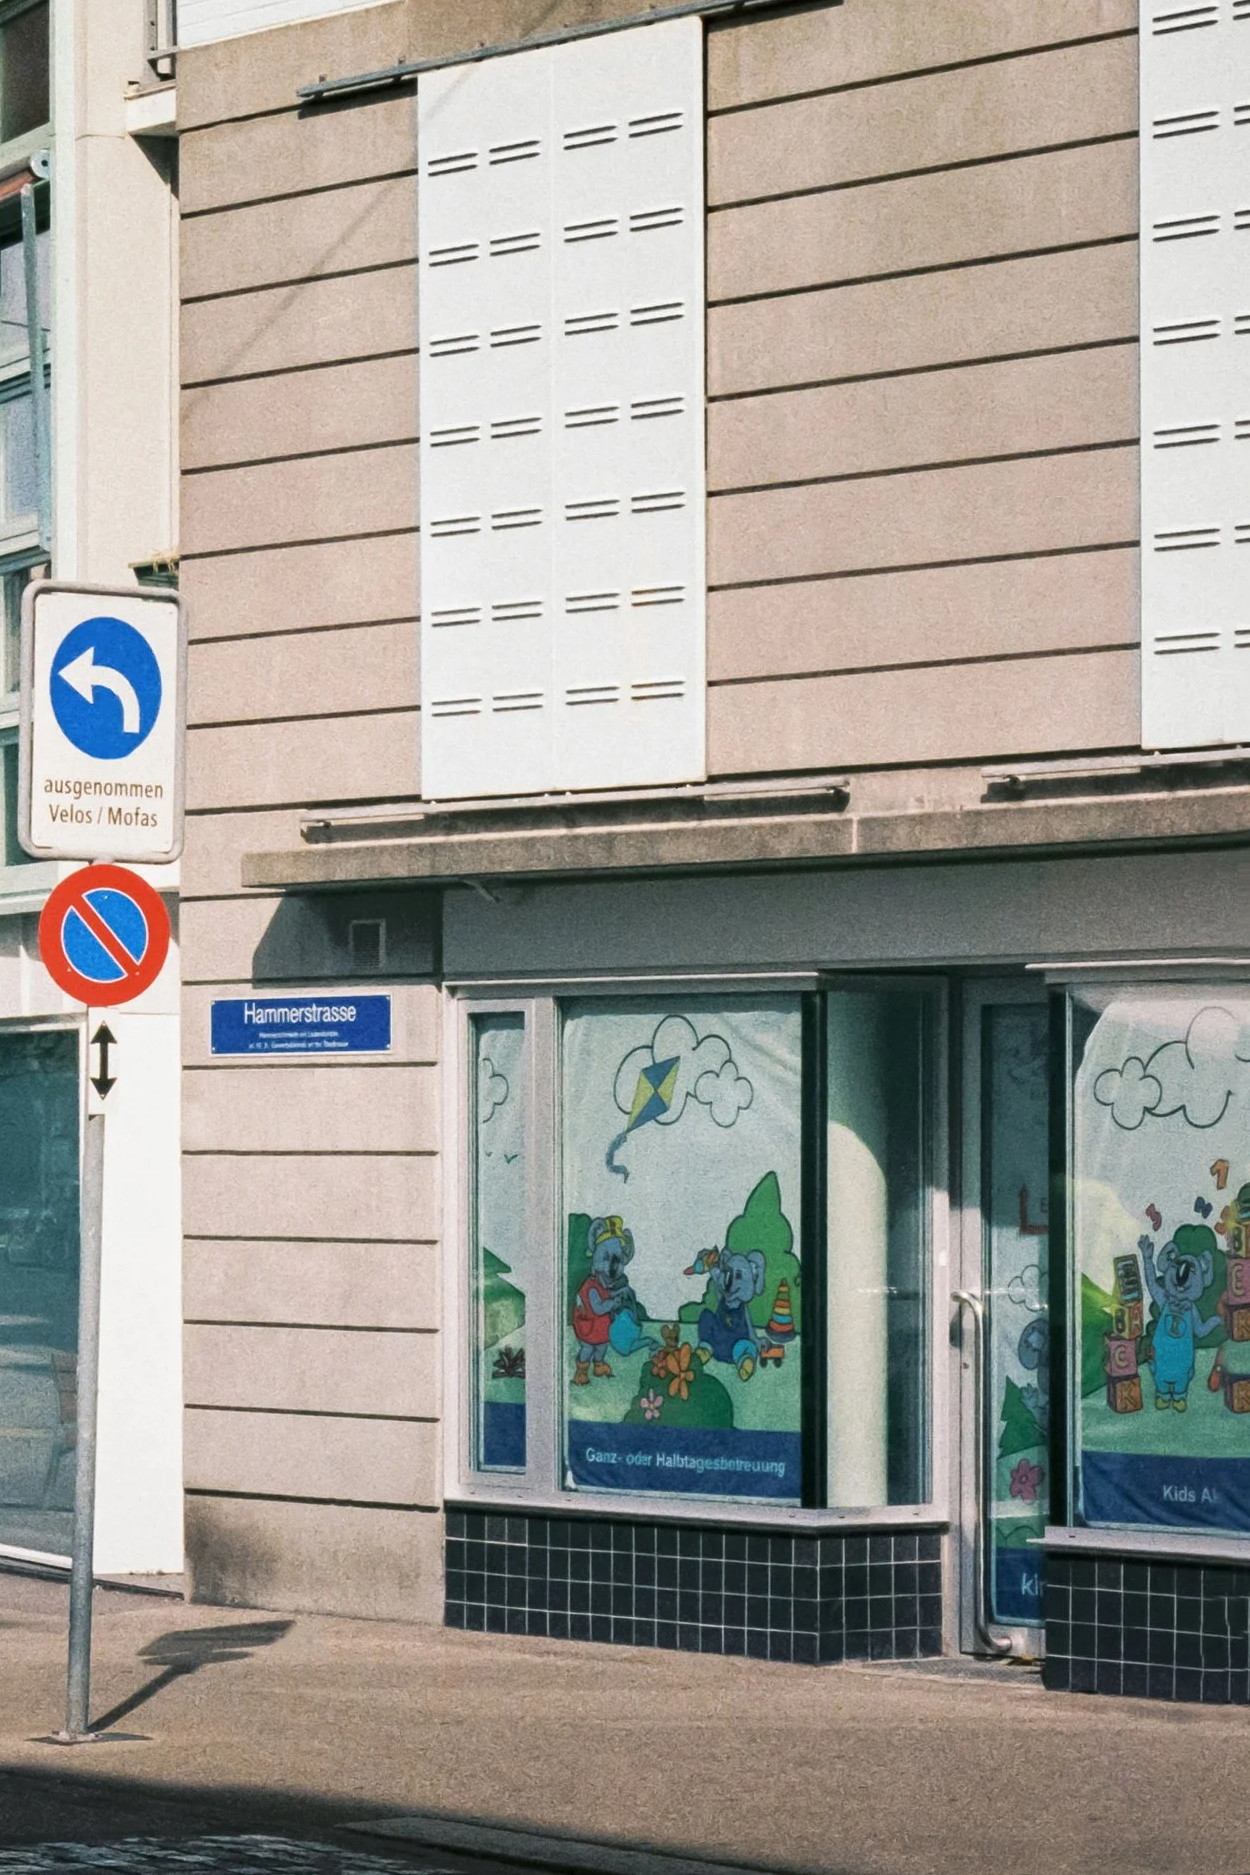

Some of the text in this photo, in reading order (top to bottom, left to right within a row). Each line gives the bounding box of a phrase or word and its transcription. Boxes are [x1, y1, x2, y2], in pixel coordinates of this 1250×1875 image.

[44, 779, 163, 800] ausgenommen
[49, 804, 157, 827] Velos / Mofas
[244, 1002, 357, 1024] Hammerstrasse
[586, 1447, 622, 1464] Ganz-
[626, 1454, 652, 1466] oder
[1163, 1485, 1196, 1503] Kids
